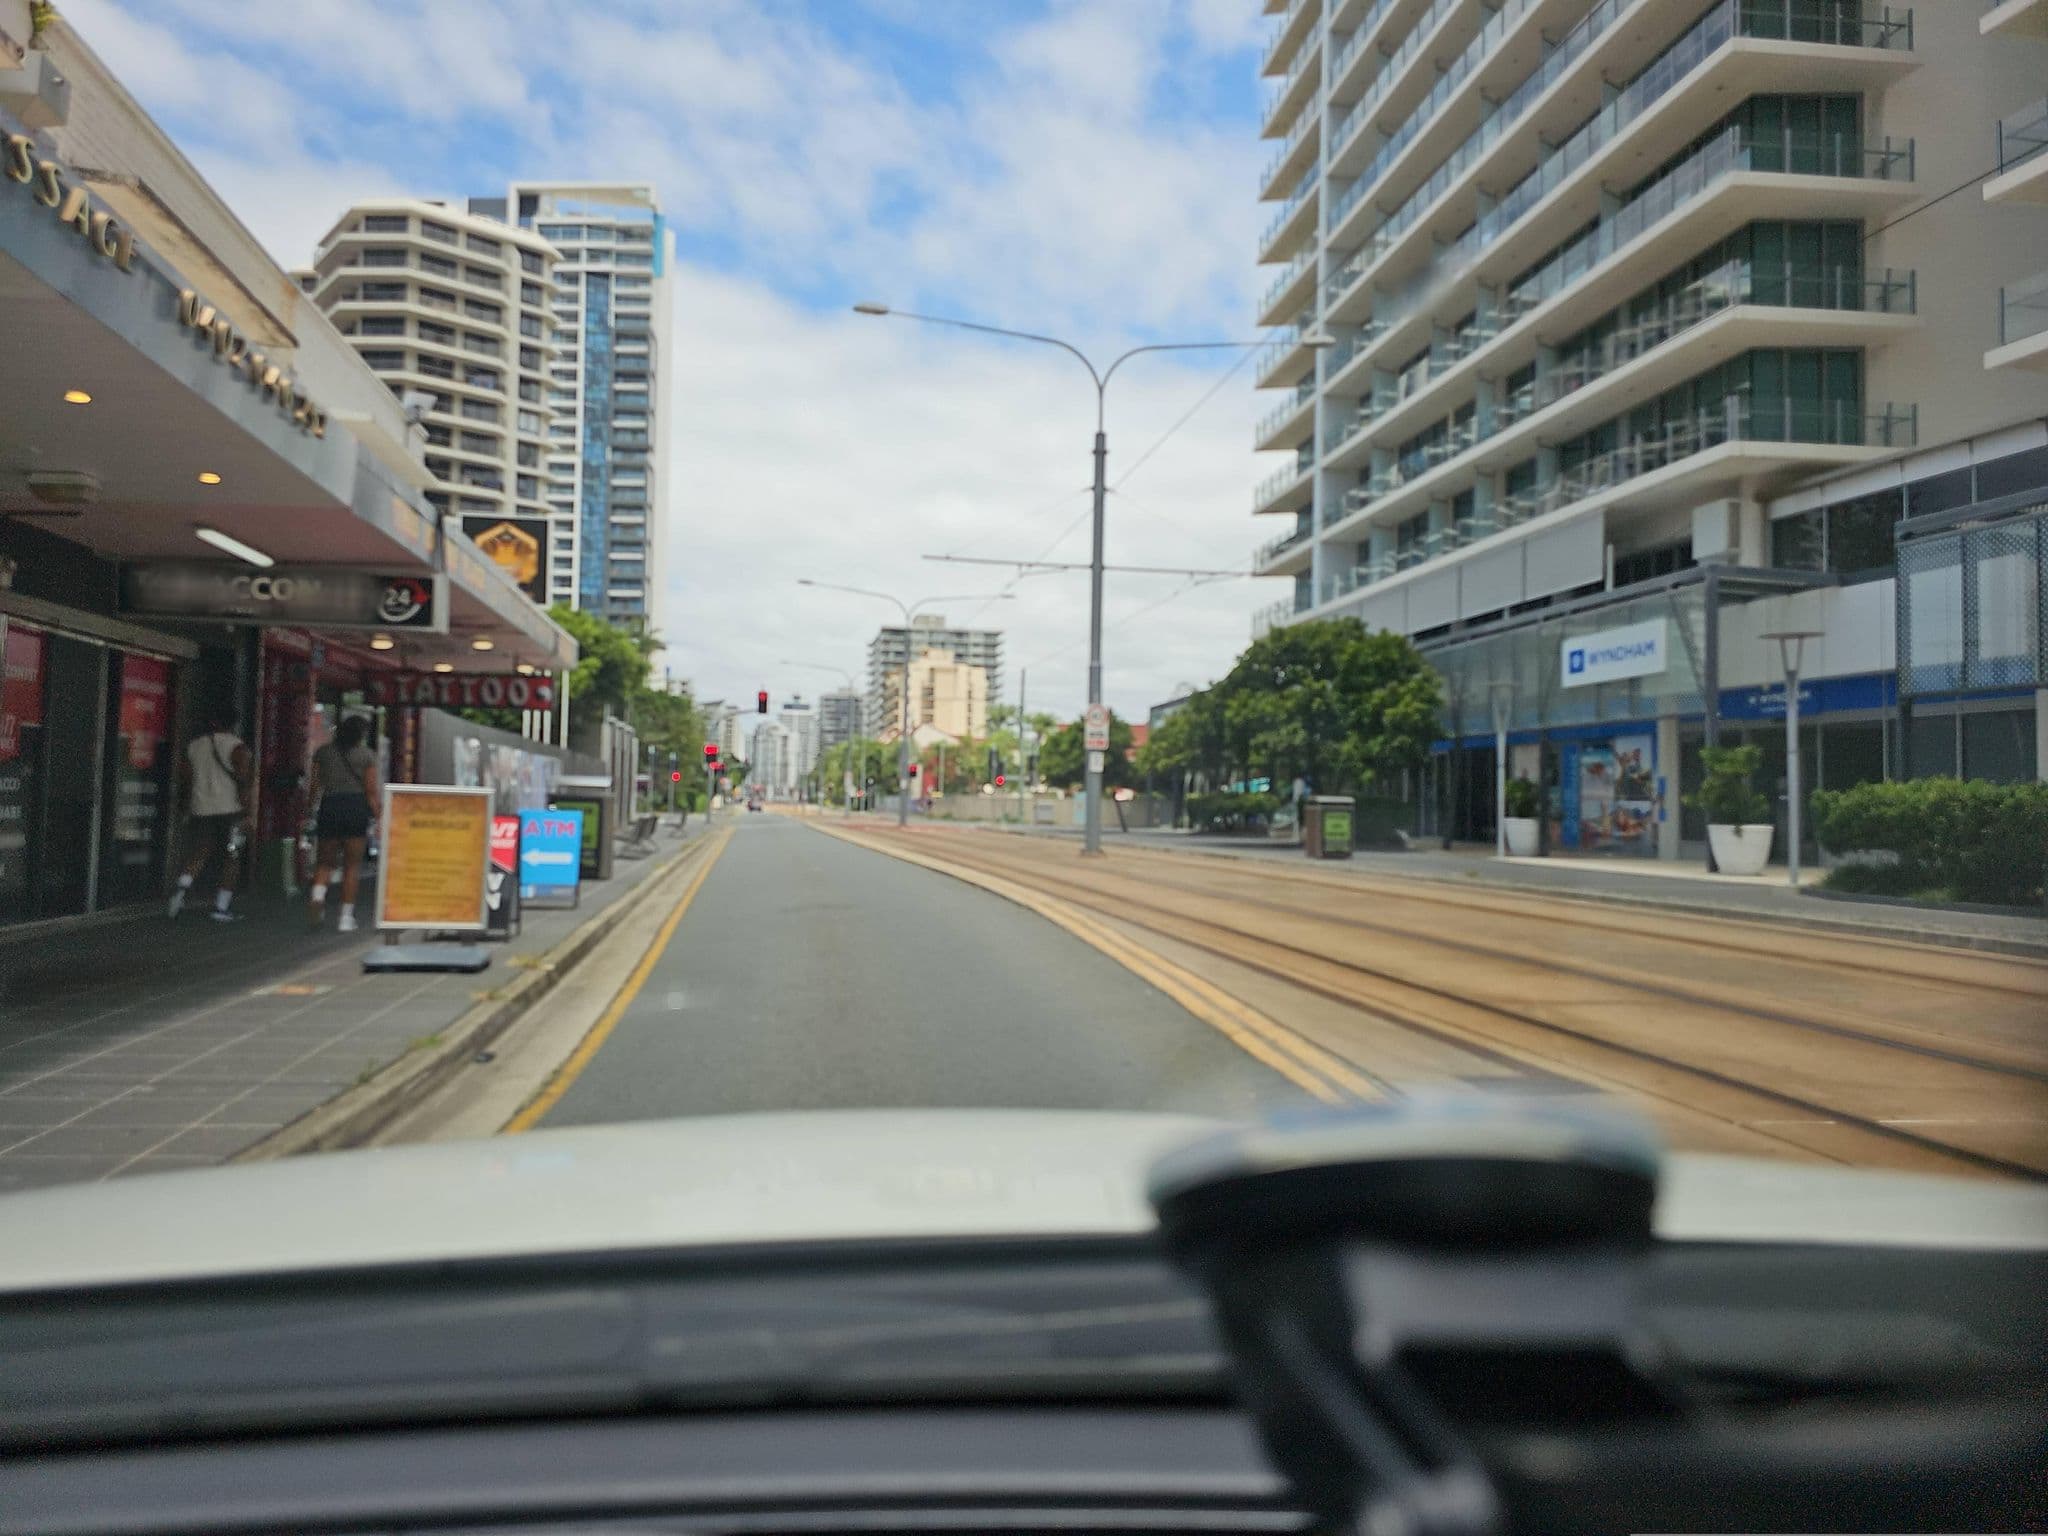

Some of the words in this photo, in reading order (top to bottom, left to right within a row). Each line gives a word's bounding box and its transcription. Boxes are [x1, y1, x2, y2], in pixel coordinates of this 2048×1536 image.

[386, 587, 411, 605] 24
[395, 676, 529, 706] TATTOO
[524, 820, 576, 837] ATM
